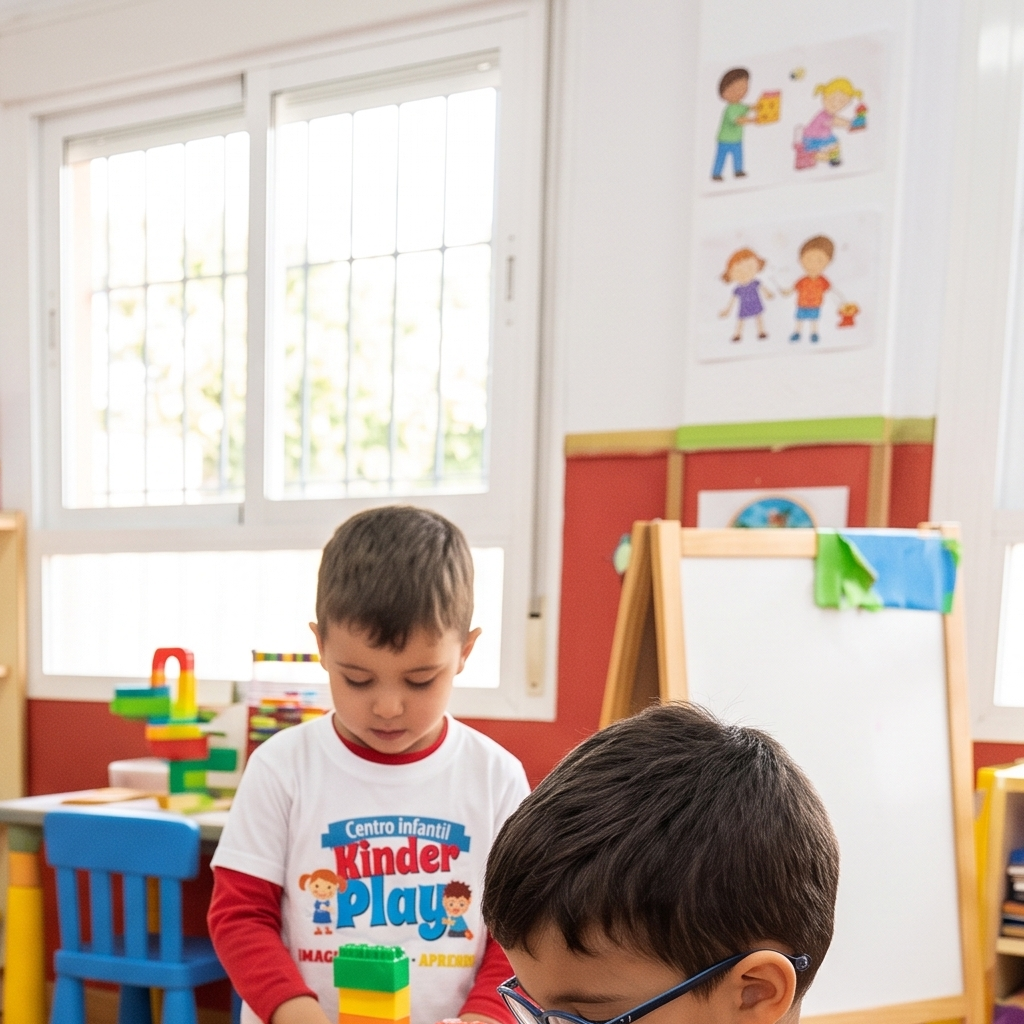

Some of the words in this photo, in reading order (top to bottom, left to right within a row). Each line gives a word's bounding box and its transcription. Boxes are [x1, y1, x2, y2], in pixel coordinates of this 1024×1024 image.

[345, 819, 395, 838] Centro
[398, 817, 451, 841] infantil
[333, 836, 460, 881] Kinder
[336, 873, 448, 941] Play
